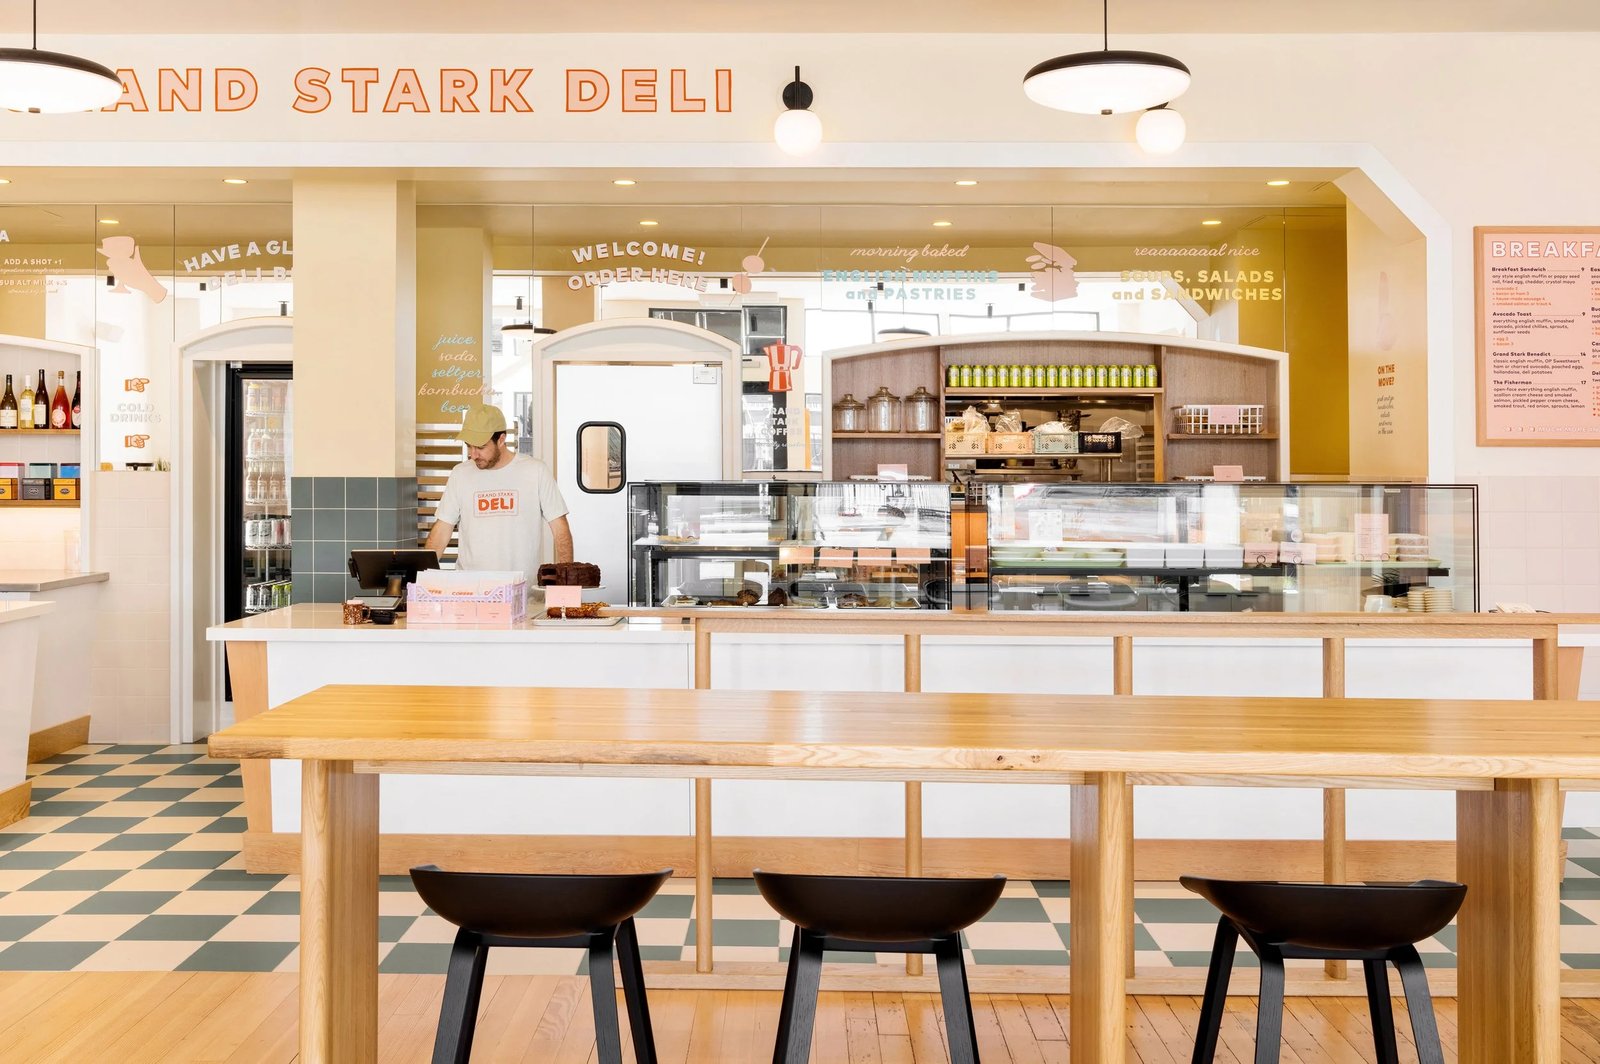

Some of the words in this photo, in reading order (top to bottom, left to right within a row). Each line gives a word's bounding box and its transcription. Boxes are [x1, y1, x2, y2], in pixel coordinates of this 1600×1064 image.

[101, 68, 258, 112] AND
[293, 67, 534, 113] STARK
[566, 68, 732, 113] DELI
[571, 241, 706, 266] WELCOME!
[849, 246, 920, 263] morning
[921, 244, 970, 258] baked
[1227, 246, 1260, 256] nice
[1491, 240, 1600, 258] BREAKF
[183, 244, 241, 272] HAVE
[246, 241, 262, 257] A
[568, 267, 644, 291] ORDER
[650, 267, 709, 293] HERE
[823, 269, 907, 282] ENGLISH
[913, 269, 999, 283] MUFFINS
[1120, 270, 1191, 283] SOUPS,
[1198, 270, 1275, 283] SALADS
[846, 288, 878, 300] and
[884, 288, 977, 300] PASTRIES
[1112, 288, 1145, 301] and
[1151, 288, 1282, 301] SANDWICHES
[1377, 365, 1385, 374] ON
[1385, 364, 1395, 373] THE
[1378, 377, 1395, 387] MOVE?
[117, 403, 154, 413] COLD
[110, 414, 162, 423] DRINKS
[478, 497, 514, 511] DELI
